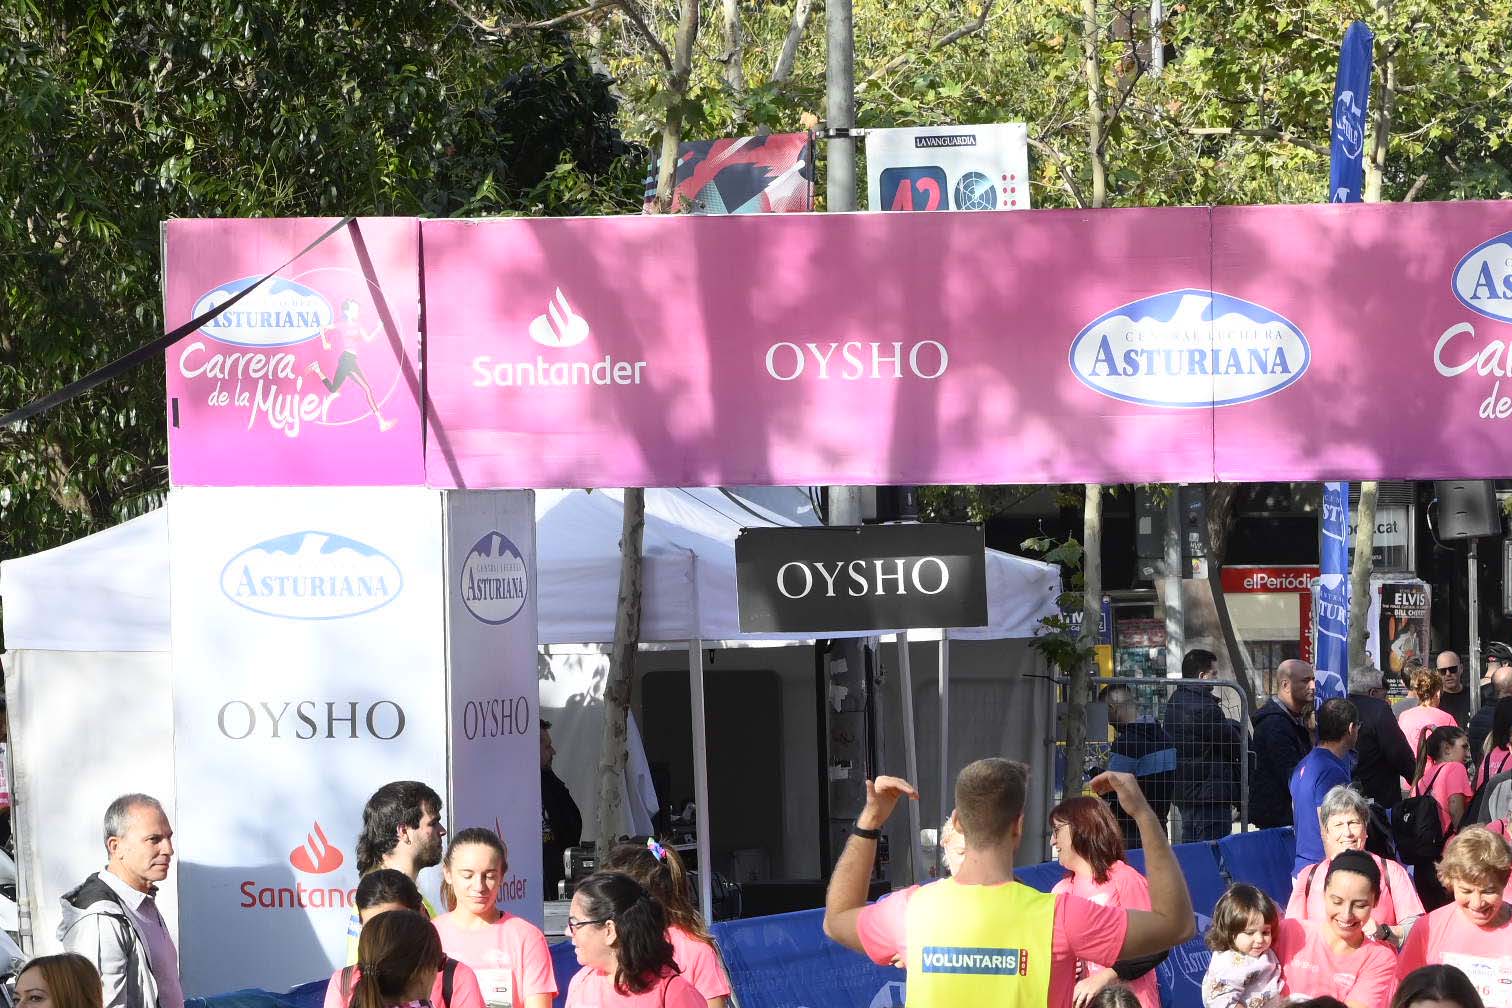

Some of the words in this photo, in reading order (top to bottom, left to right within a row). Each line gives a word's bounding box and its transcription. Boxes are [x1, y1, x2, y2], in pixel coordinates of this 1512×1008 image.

[924, 136, 976, 146] VANGUARDIA
[202, 301, 321, 329] ASTURIANA
[179, 341, 296, 383] Carrera
[472, 355, 647, 387] Santander
[765, 340, 949, 382] OYSHO
[1089, 334, 1292, 378] ASTURIANA
[208, 379, 232, 408] de
[234, 379, 250, 408] la
[248, 375, 341, 438] Mujer
[235, 564, 389, 598] ASTURIANA
[466, 571, 525, 602] ASTURIANA
[777, 556, 950, 600] OYSHO
[1394, 592, 1425, 606] ELVIS
[217, 699, 406, 741] OYSHO
[464, 695, 529, 741] OYSHO
[923, 953, 1016, 969] VOLUNTARIS
